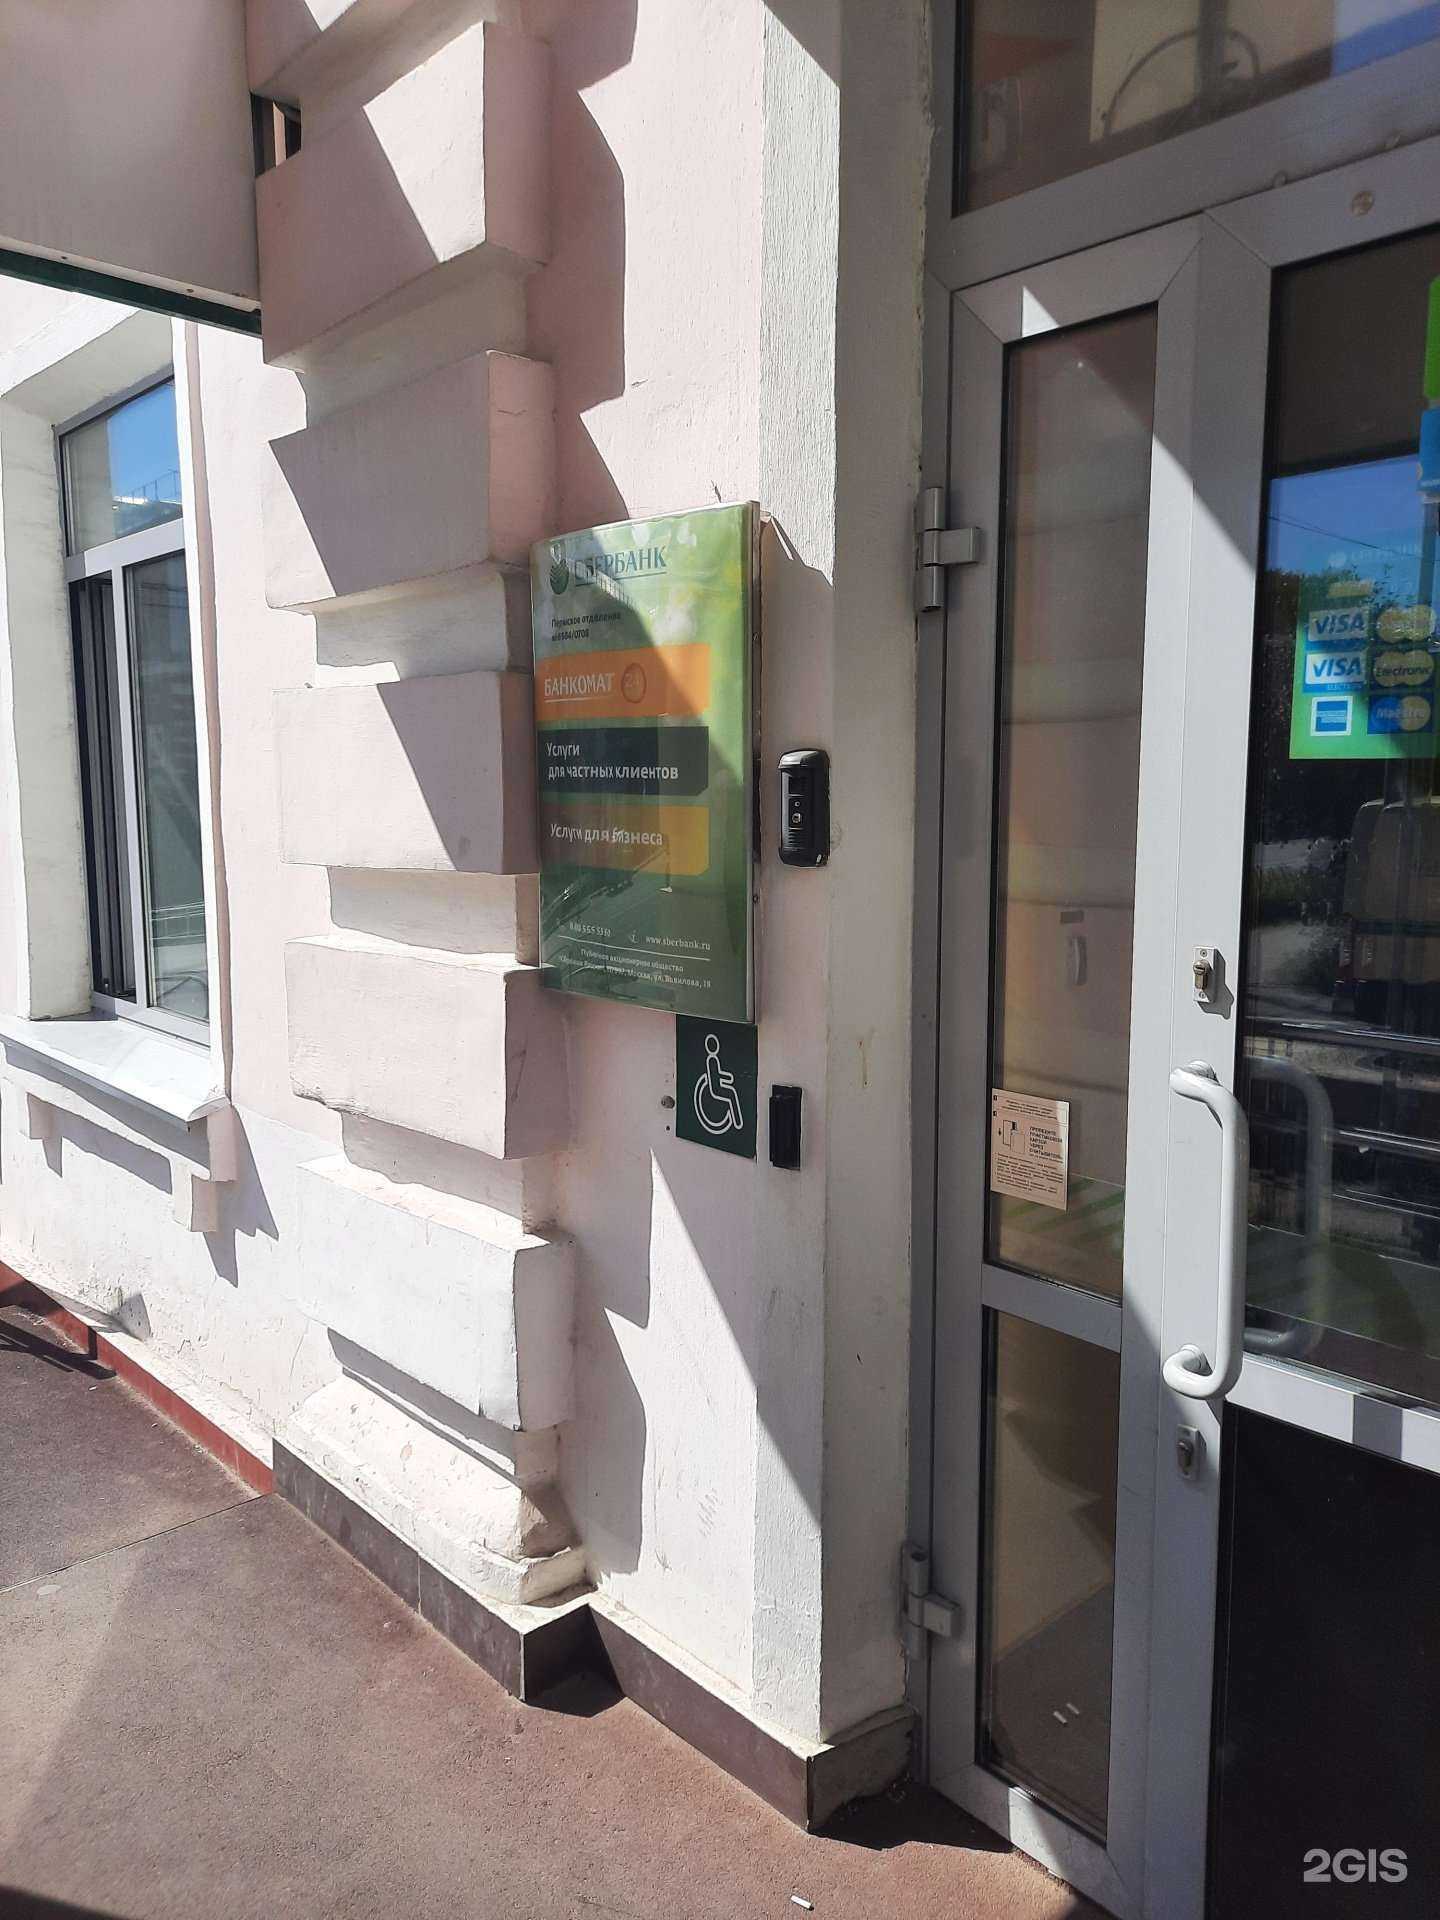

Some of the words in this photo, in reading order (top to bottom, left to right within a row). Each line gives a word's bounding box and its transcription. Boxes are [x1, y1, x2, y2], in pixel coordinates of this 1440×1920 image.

[574, 545, 667, 579] СБЕРБАНК
[1314, 613, 1365, 634] VISA
[1313, 658, 1362, 678] VISA
[543, 672, 615, 697] БАНКОМАТ
[546, 742, 580, 760] Услуги
[548, 765, 566, 781] для
[566, 765, 614, 779] частных
[615, 764, 679, 780] клиентов
[550, 823, 583, 842] Услуги
[584, 827, 609, 845] для
[612, 827, 664, 847] бизнеса
[645, 935, 711, 951] www.sberbank.ru
